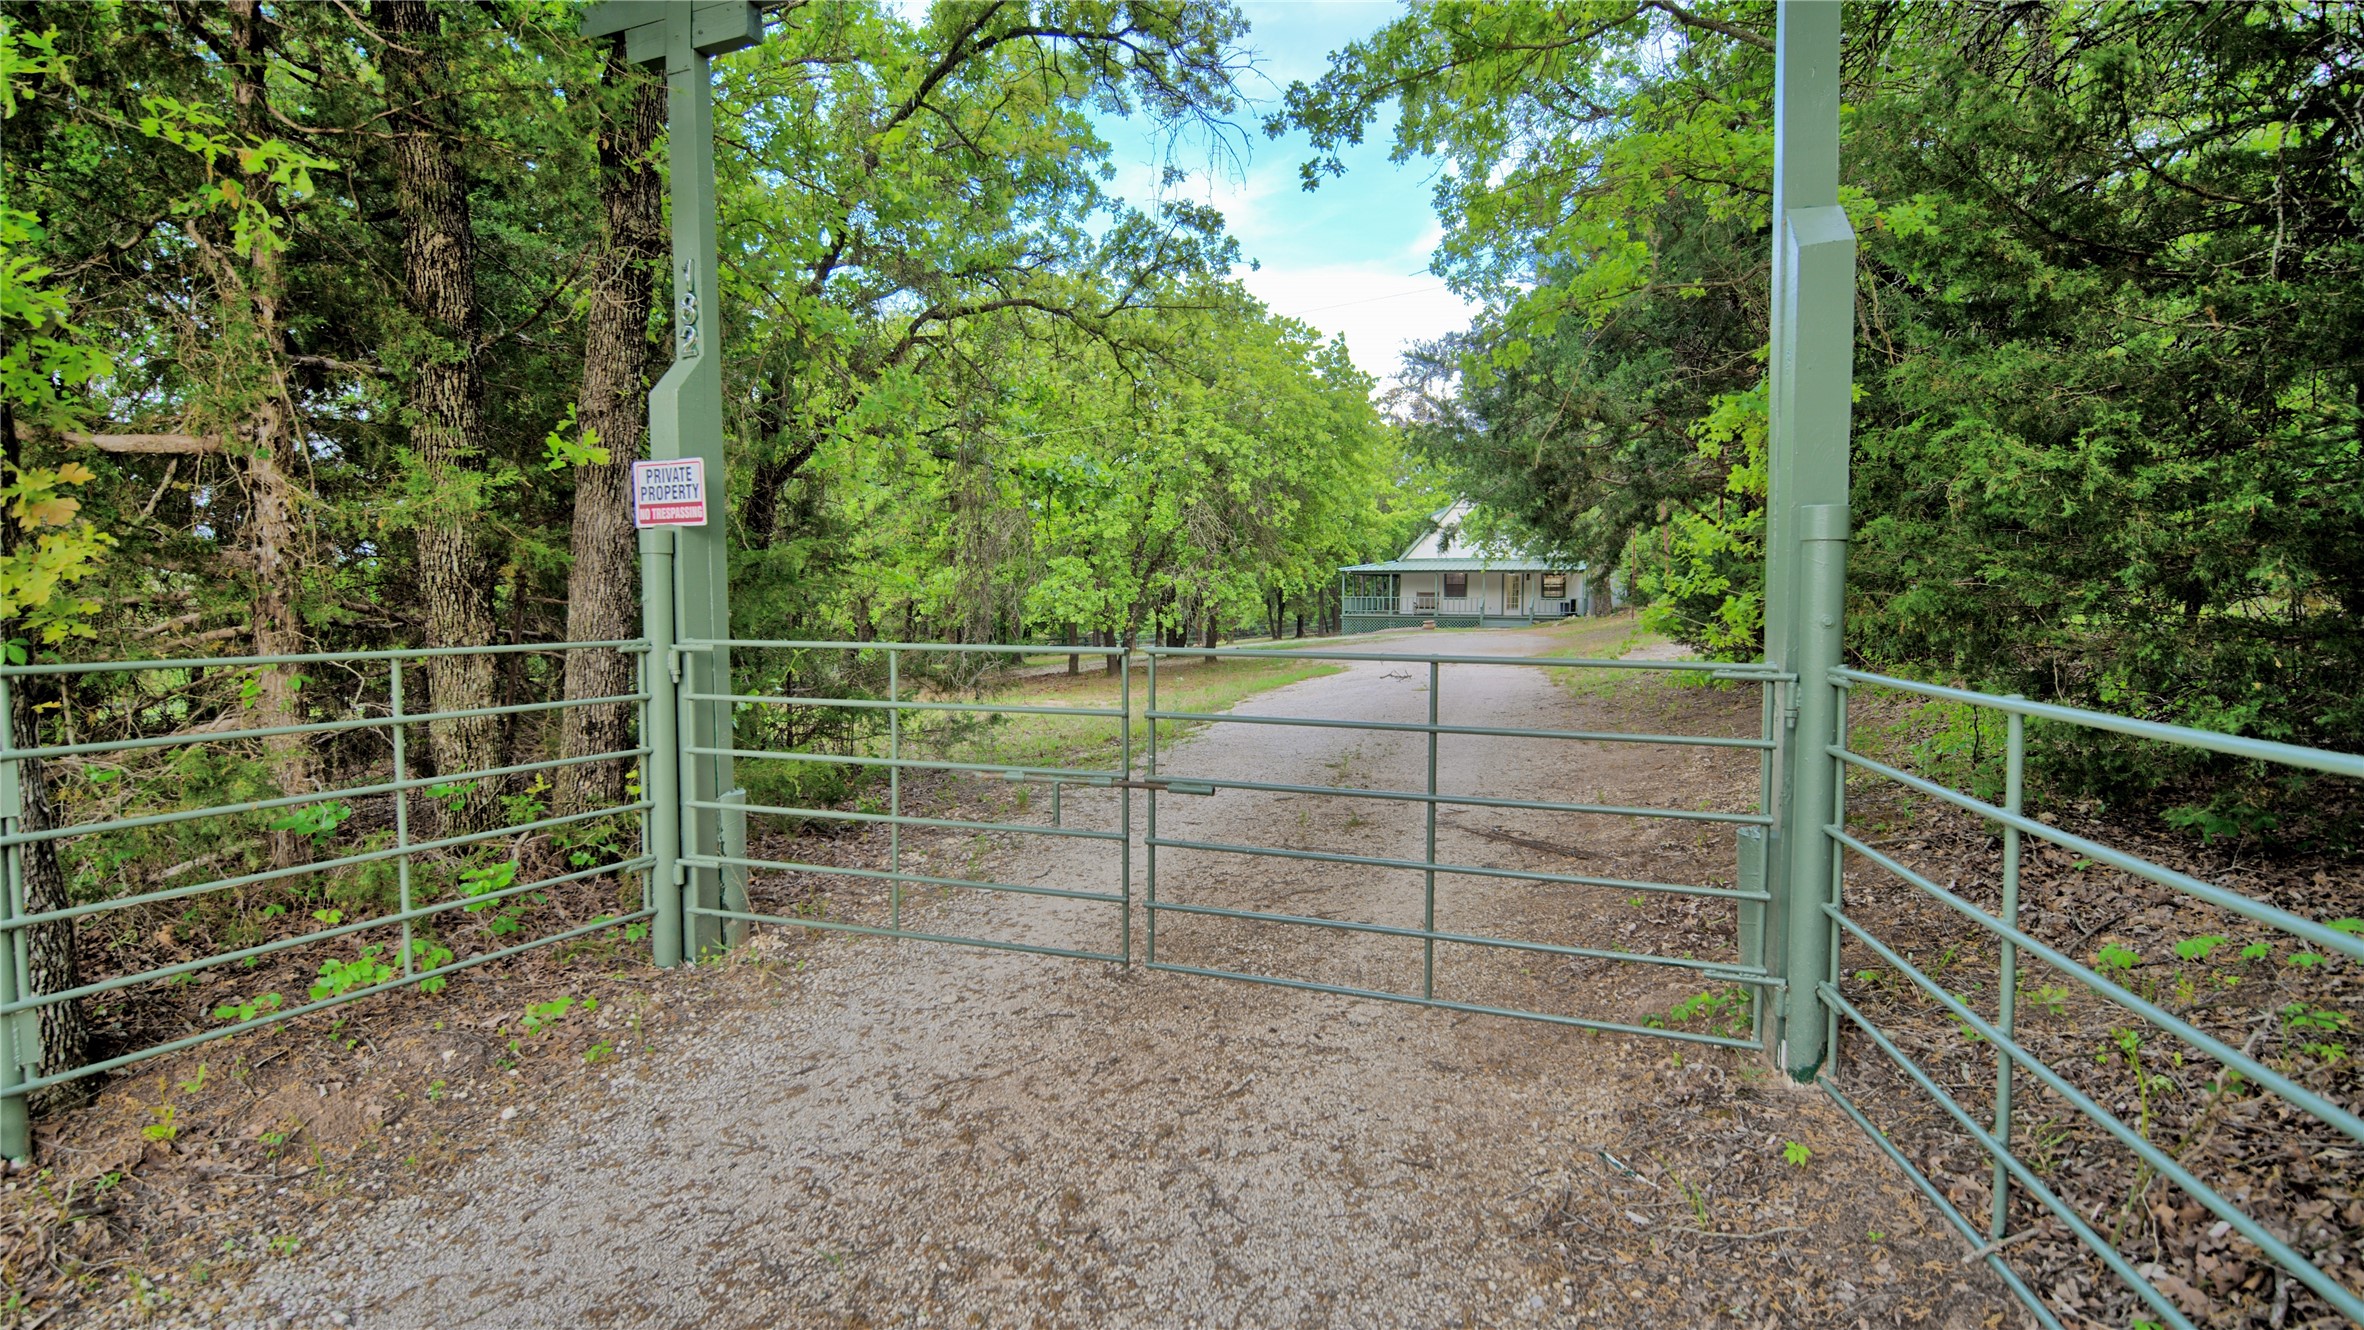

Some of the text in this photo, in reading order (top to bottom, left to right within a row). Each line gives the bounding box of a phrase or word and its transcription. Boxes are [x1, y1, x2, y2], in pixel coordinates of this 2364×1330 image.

[679, 259, 698, 356] 182
[646, 466, 692, 484] PRIVATE
[641, 483, 699, 501] PROPERTY
[640, 506, 702, 520] NO TRESPASSING
